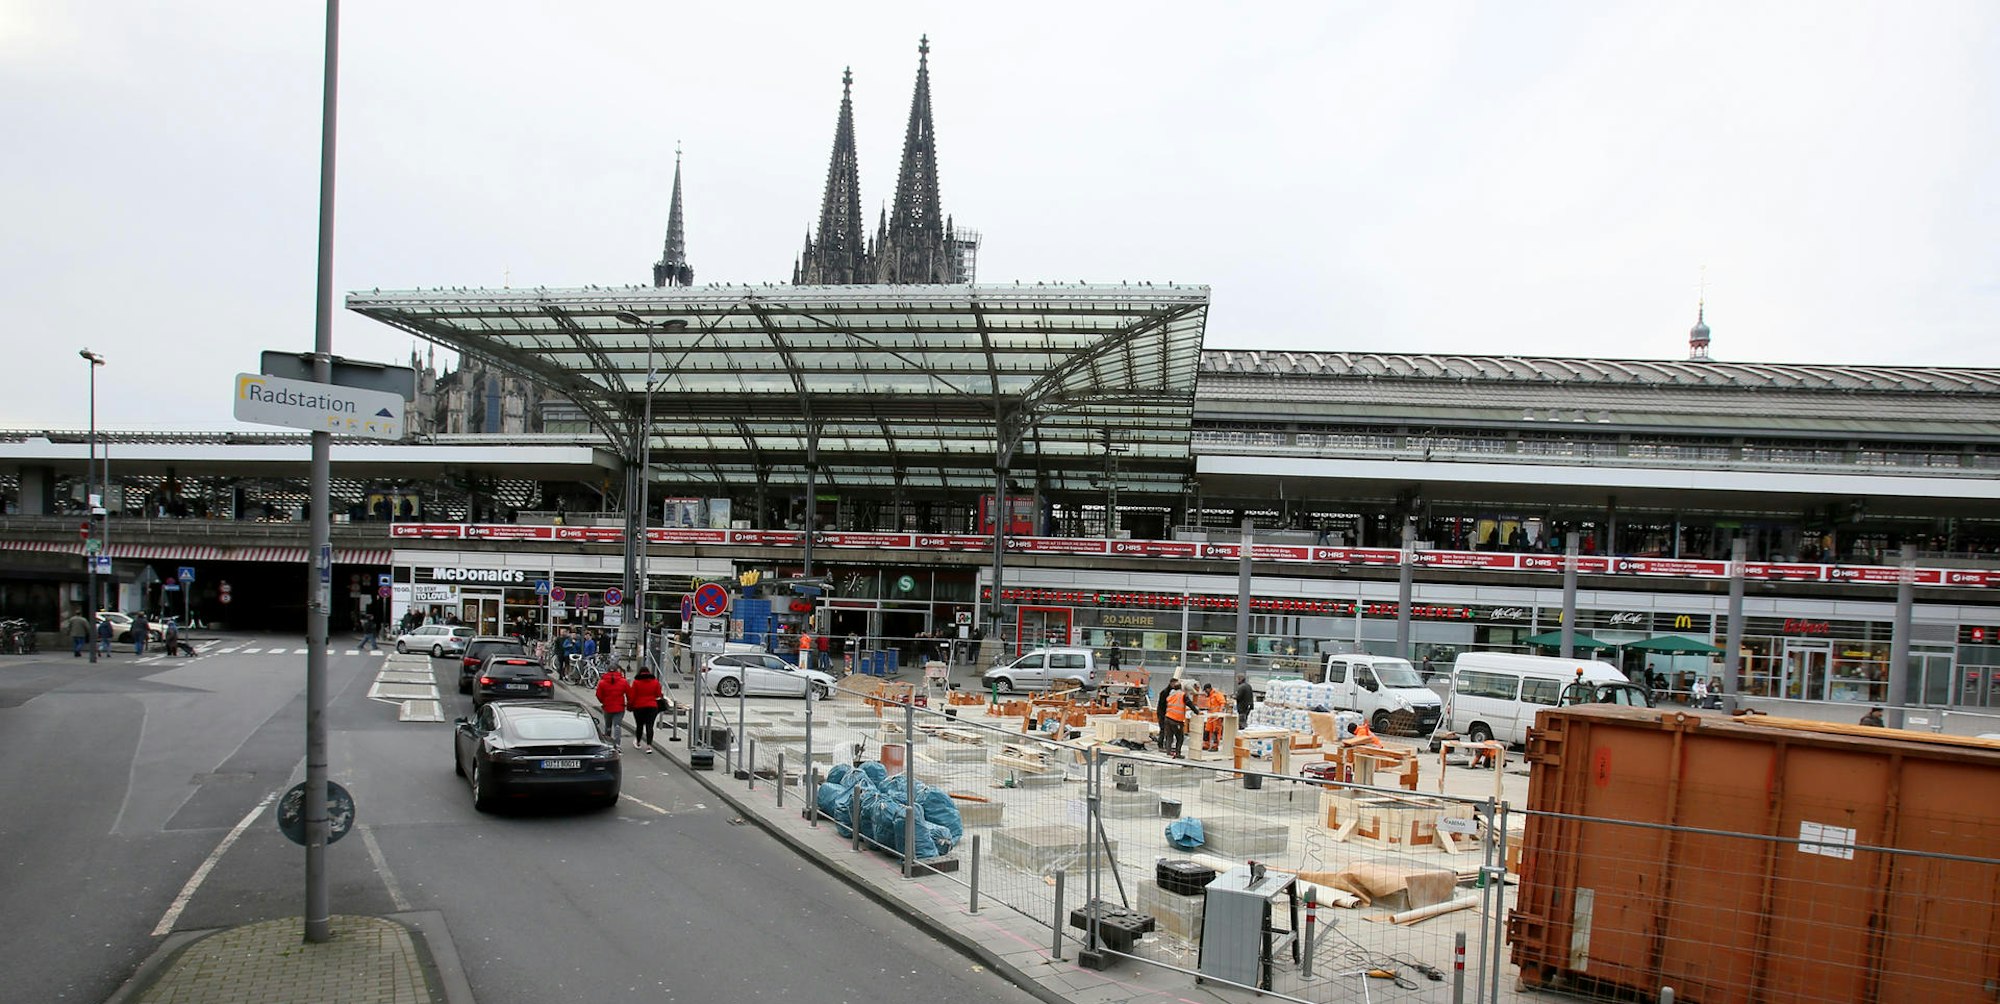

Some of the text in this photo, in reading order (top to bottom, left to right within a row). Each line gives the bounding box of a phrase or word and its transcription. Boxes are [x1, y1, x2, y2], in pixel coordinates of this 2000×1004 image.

[250, 384, 356, 412] Radstation
[1419, 554, 1436, 562] HRS
[1534, 559, 1552, 567] HRS
[1627, 562, 1646, 570] HRS
[432, 567, 524, 583] McDonald's
[1745, 567, 1763, 575] HRS
[1840, 570, 1860, 578] HRS
[1961, 574, 1981, 582] HRS
[1001, 589, 1086, 603] APOTHEKE
[1250, 598, 1340, 613] PHARMACY
[1103, 614, 1153, 626] 20 JAHRE
[1784, 617, 1830, 634] Eckert
